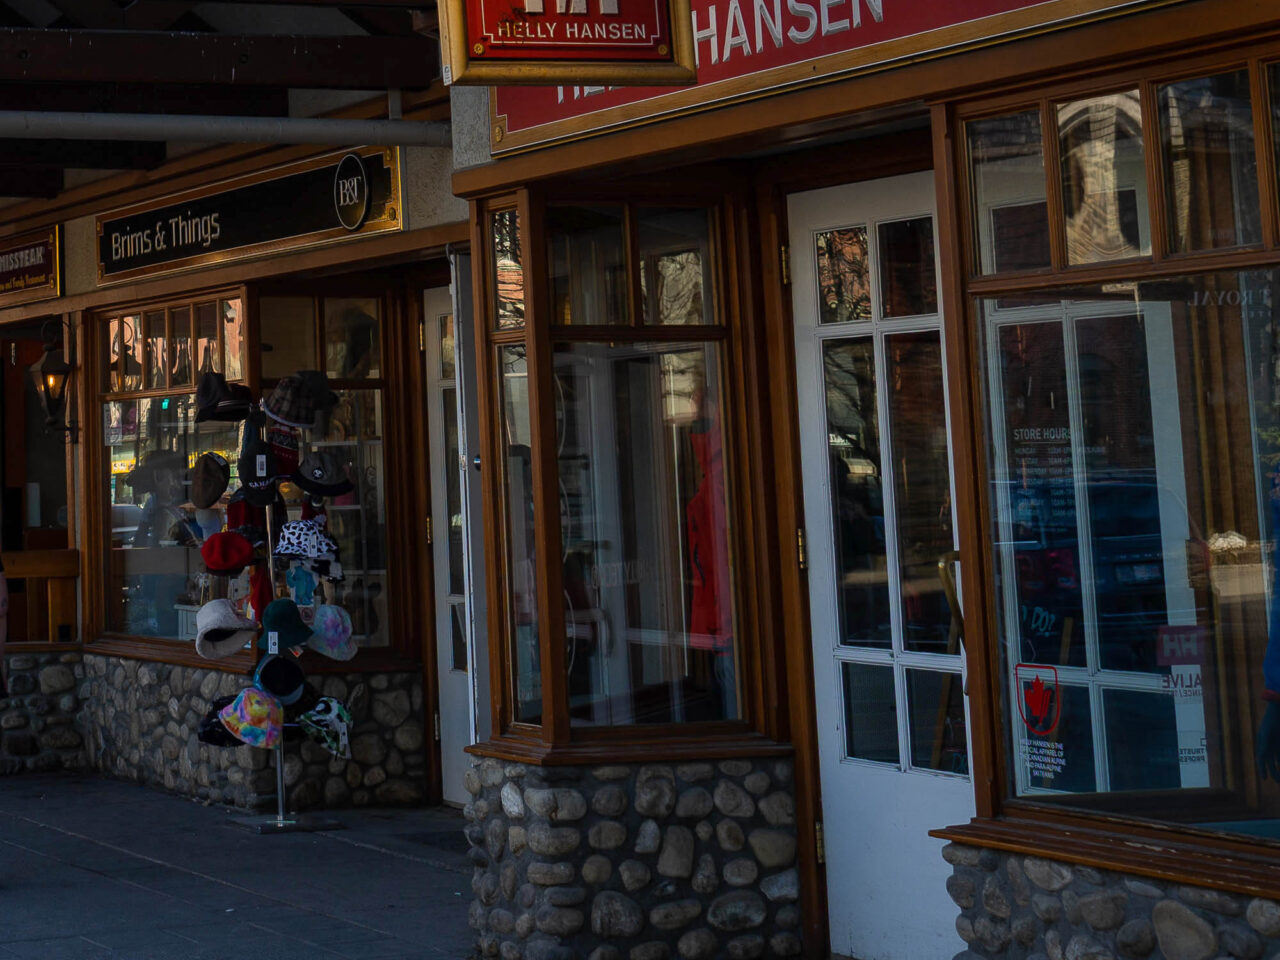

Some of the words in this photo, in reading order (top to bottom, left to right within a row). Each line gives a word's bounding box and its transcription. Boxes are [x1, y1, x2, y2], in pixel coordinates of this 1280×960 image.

[497, 22, 558, 39] HELLY
[566, 22, 646, 39] HANSEN
[111, 226, 152, 261] Brims
[154, 221, 167, 252] &
[169, 210, 221, 249] Things
[0, 246, 47, 273] MISSTEAK
[1013, 428, 1042, 441] STORE
